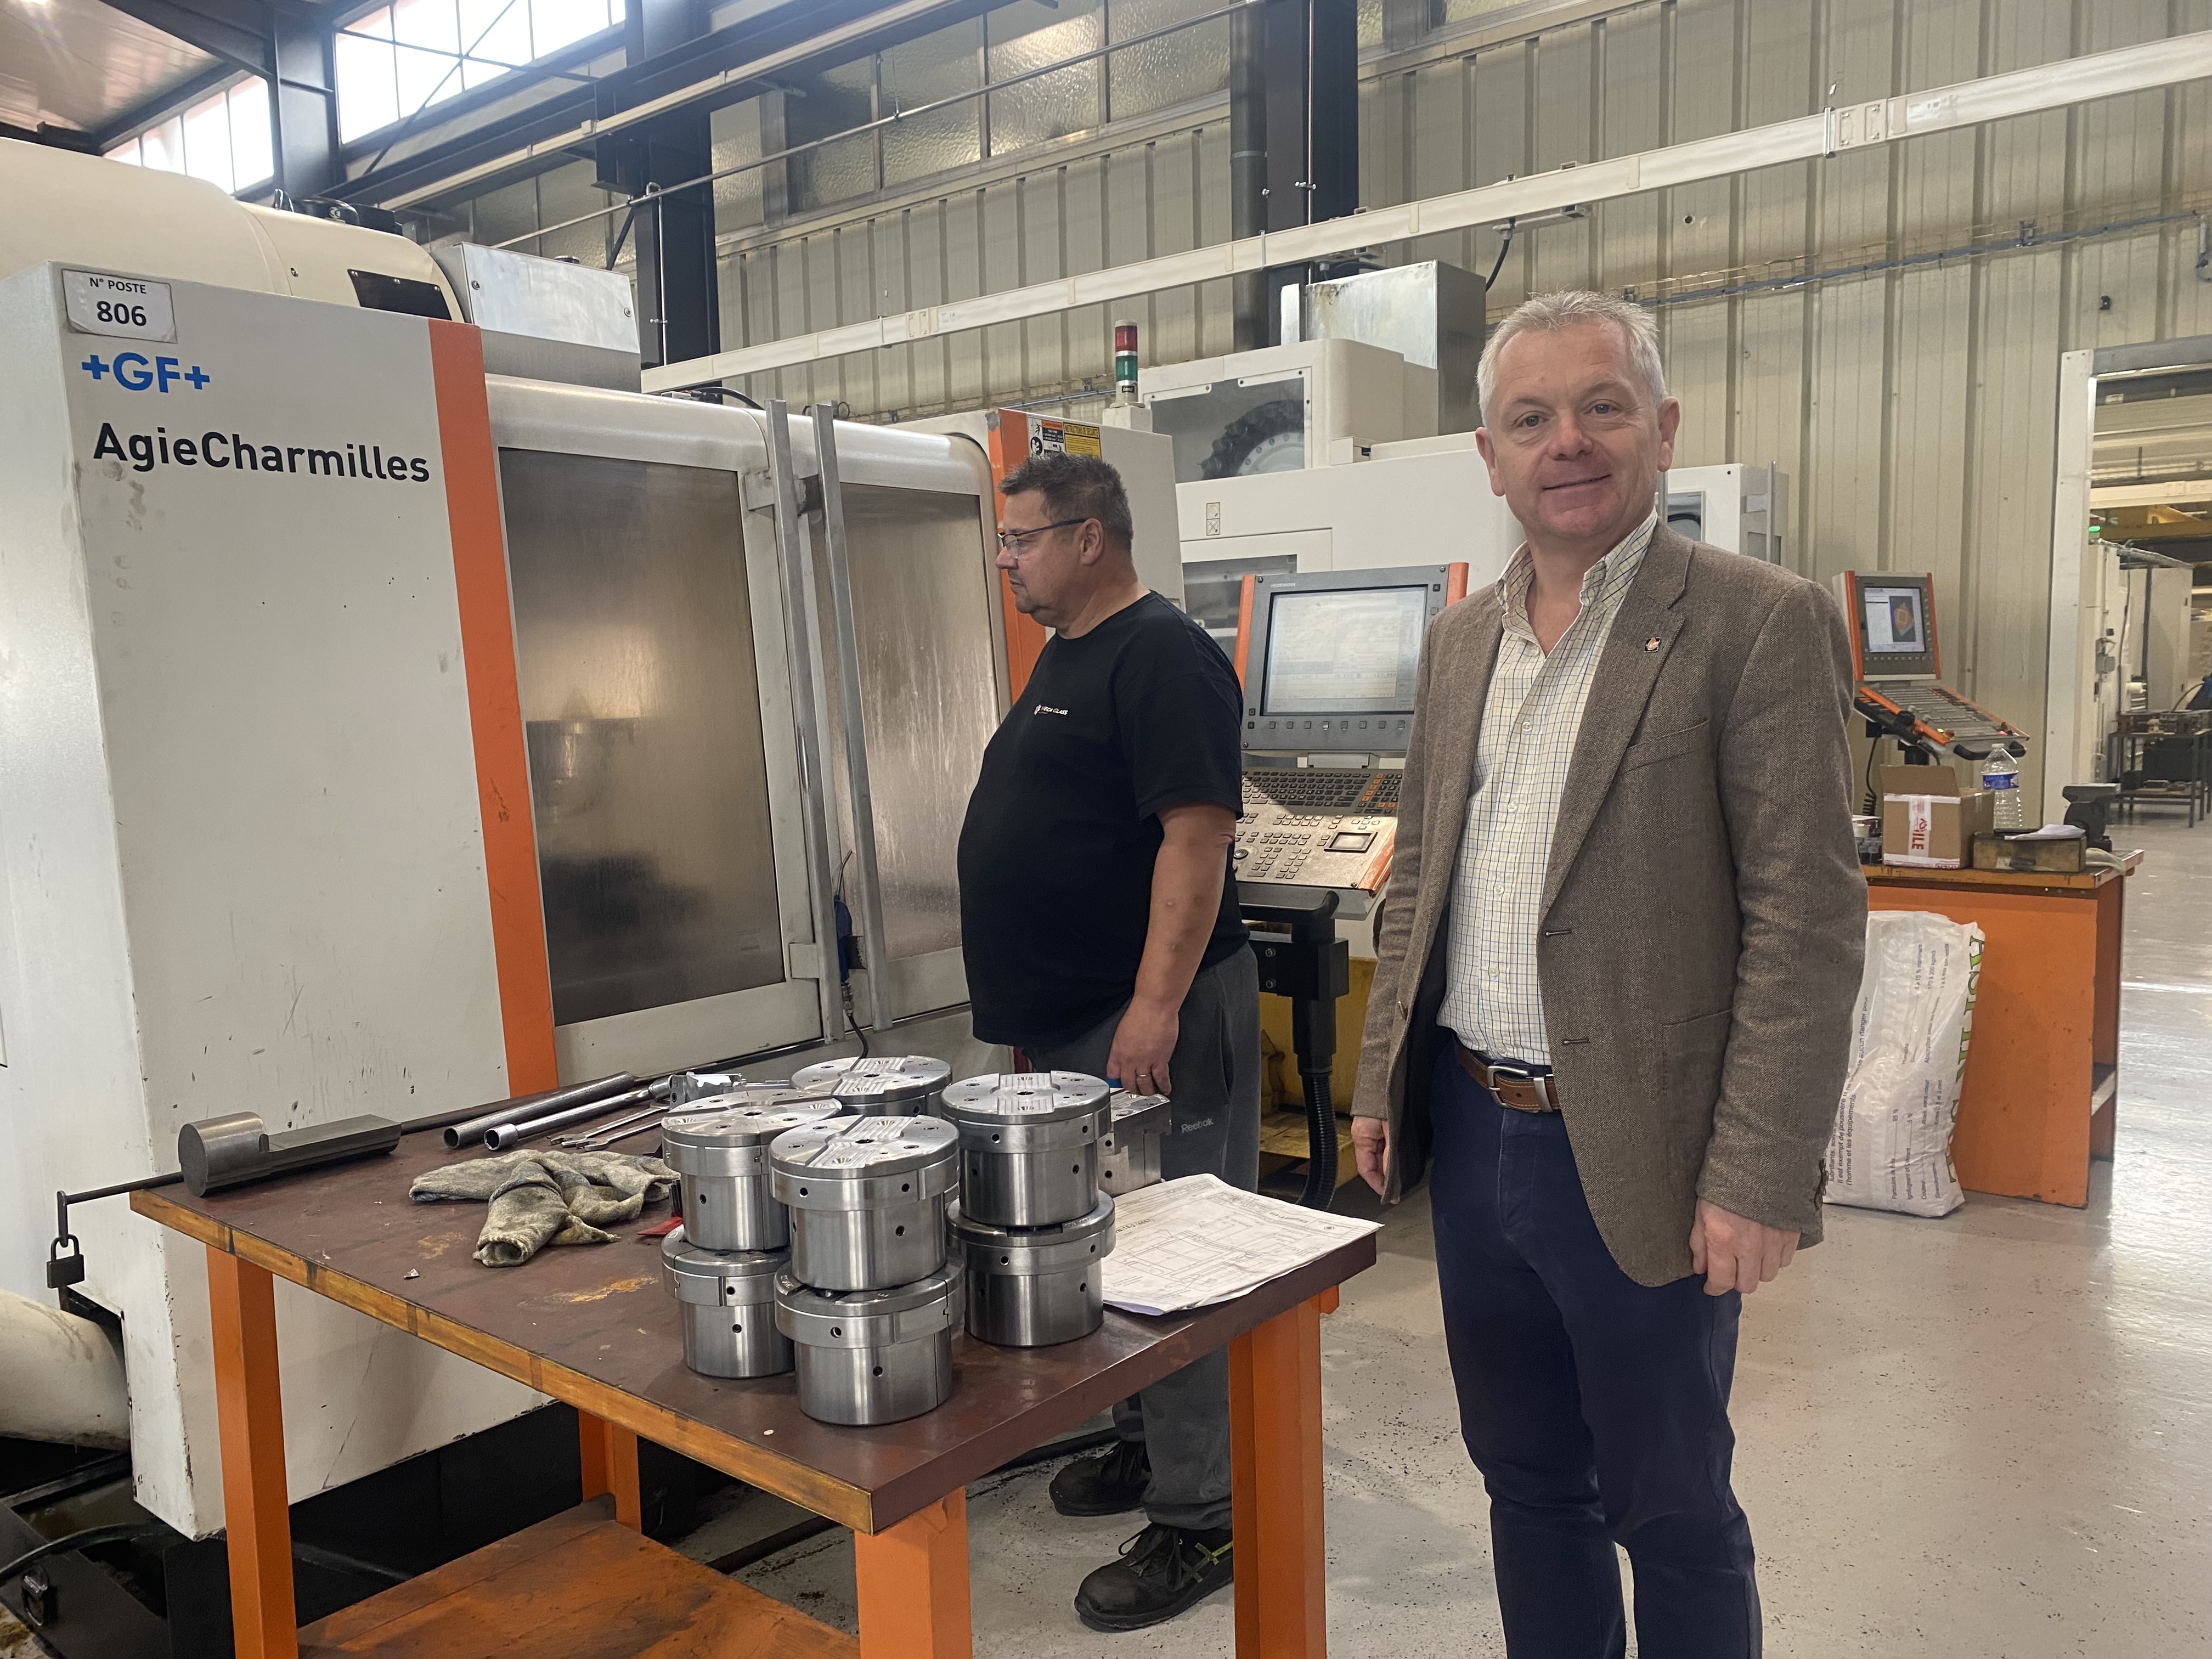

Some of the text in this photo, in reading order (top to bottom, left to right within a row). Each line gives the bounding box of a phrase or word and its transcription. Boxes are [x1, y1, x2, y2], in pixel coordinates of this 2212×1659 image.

[108, 280, 147, 294] POSTE
[97, 301, 147, 326] 806
[93, 422, 430, 482] AgieCharmilles
[1838, 1132, 1844, 1141] de
[1858, 1013, 1867, 1036] danger
[1181, 1118, 1214, 1133] Reebok
